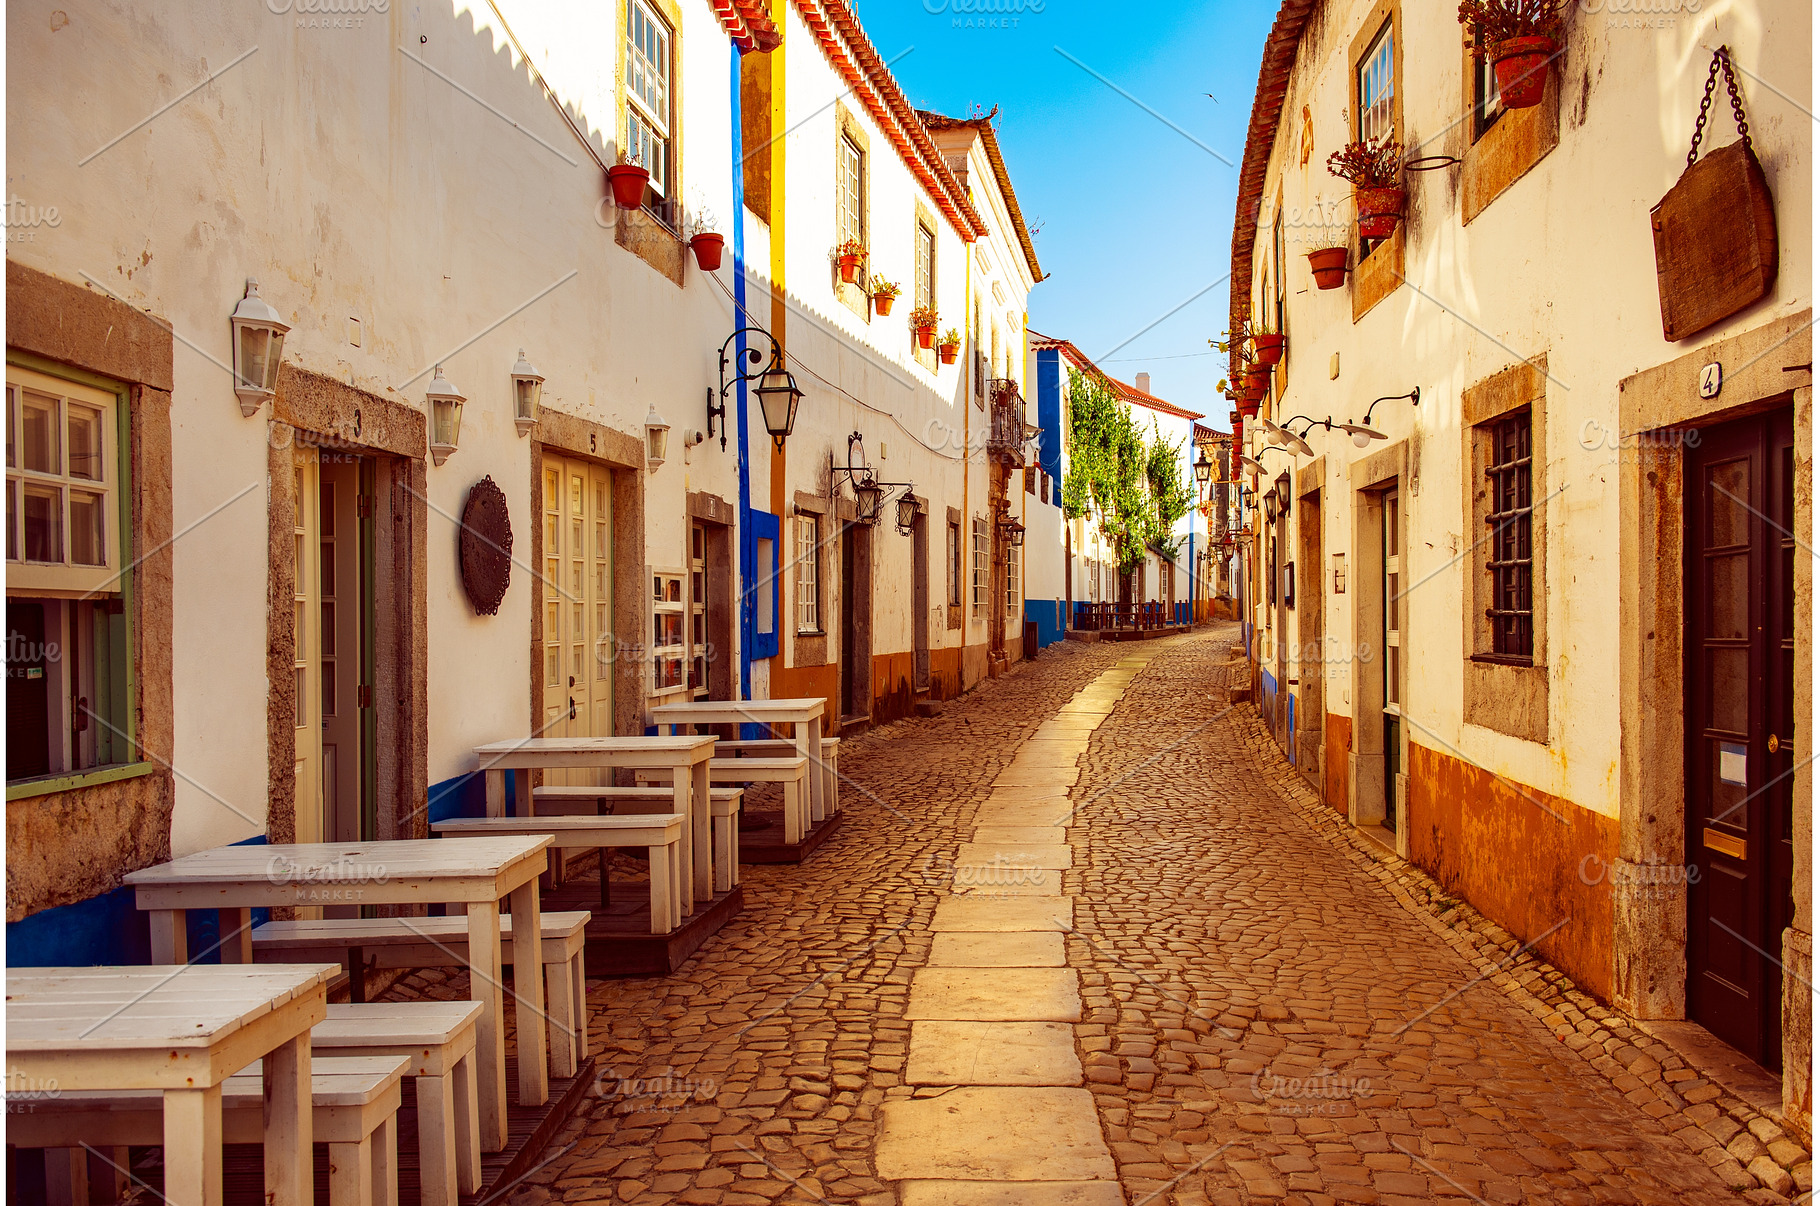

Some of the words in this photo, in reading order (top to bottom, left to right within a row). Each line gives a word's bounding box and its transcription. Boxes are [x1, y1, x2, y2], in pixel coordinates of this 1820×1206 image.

[1703, 367, 1713, 393] 4
[354, 409, 361, 438] 3
[590, 433, 596, 453] 5
